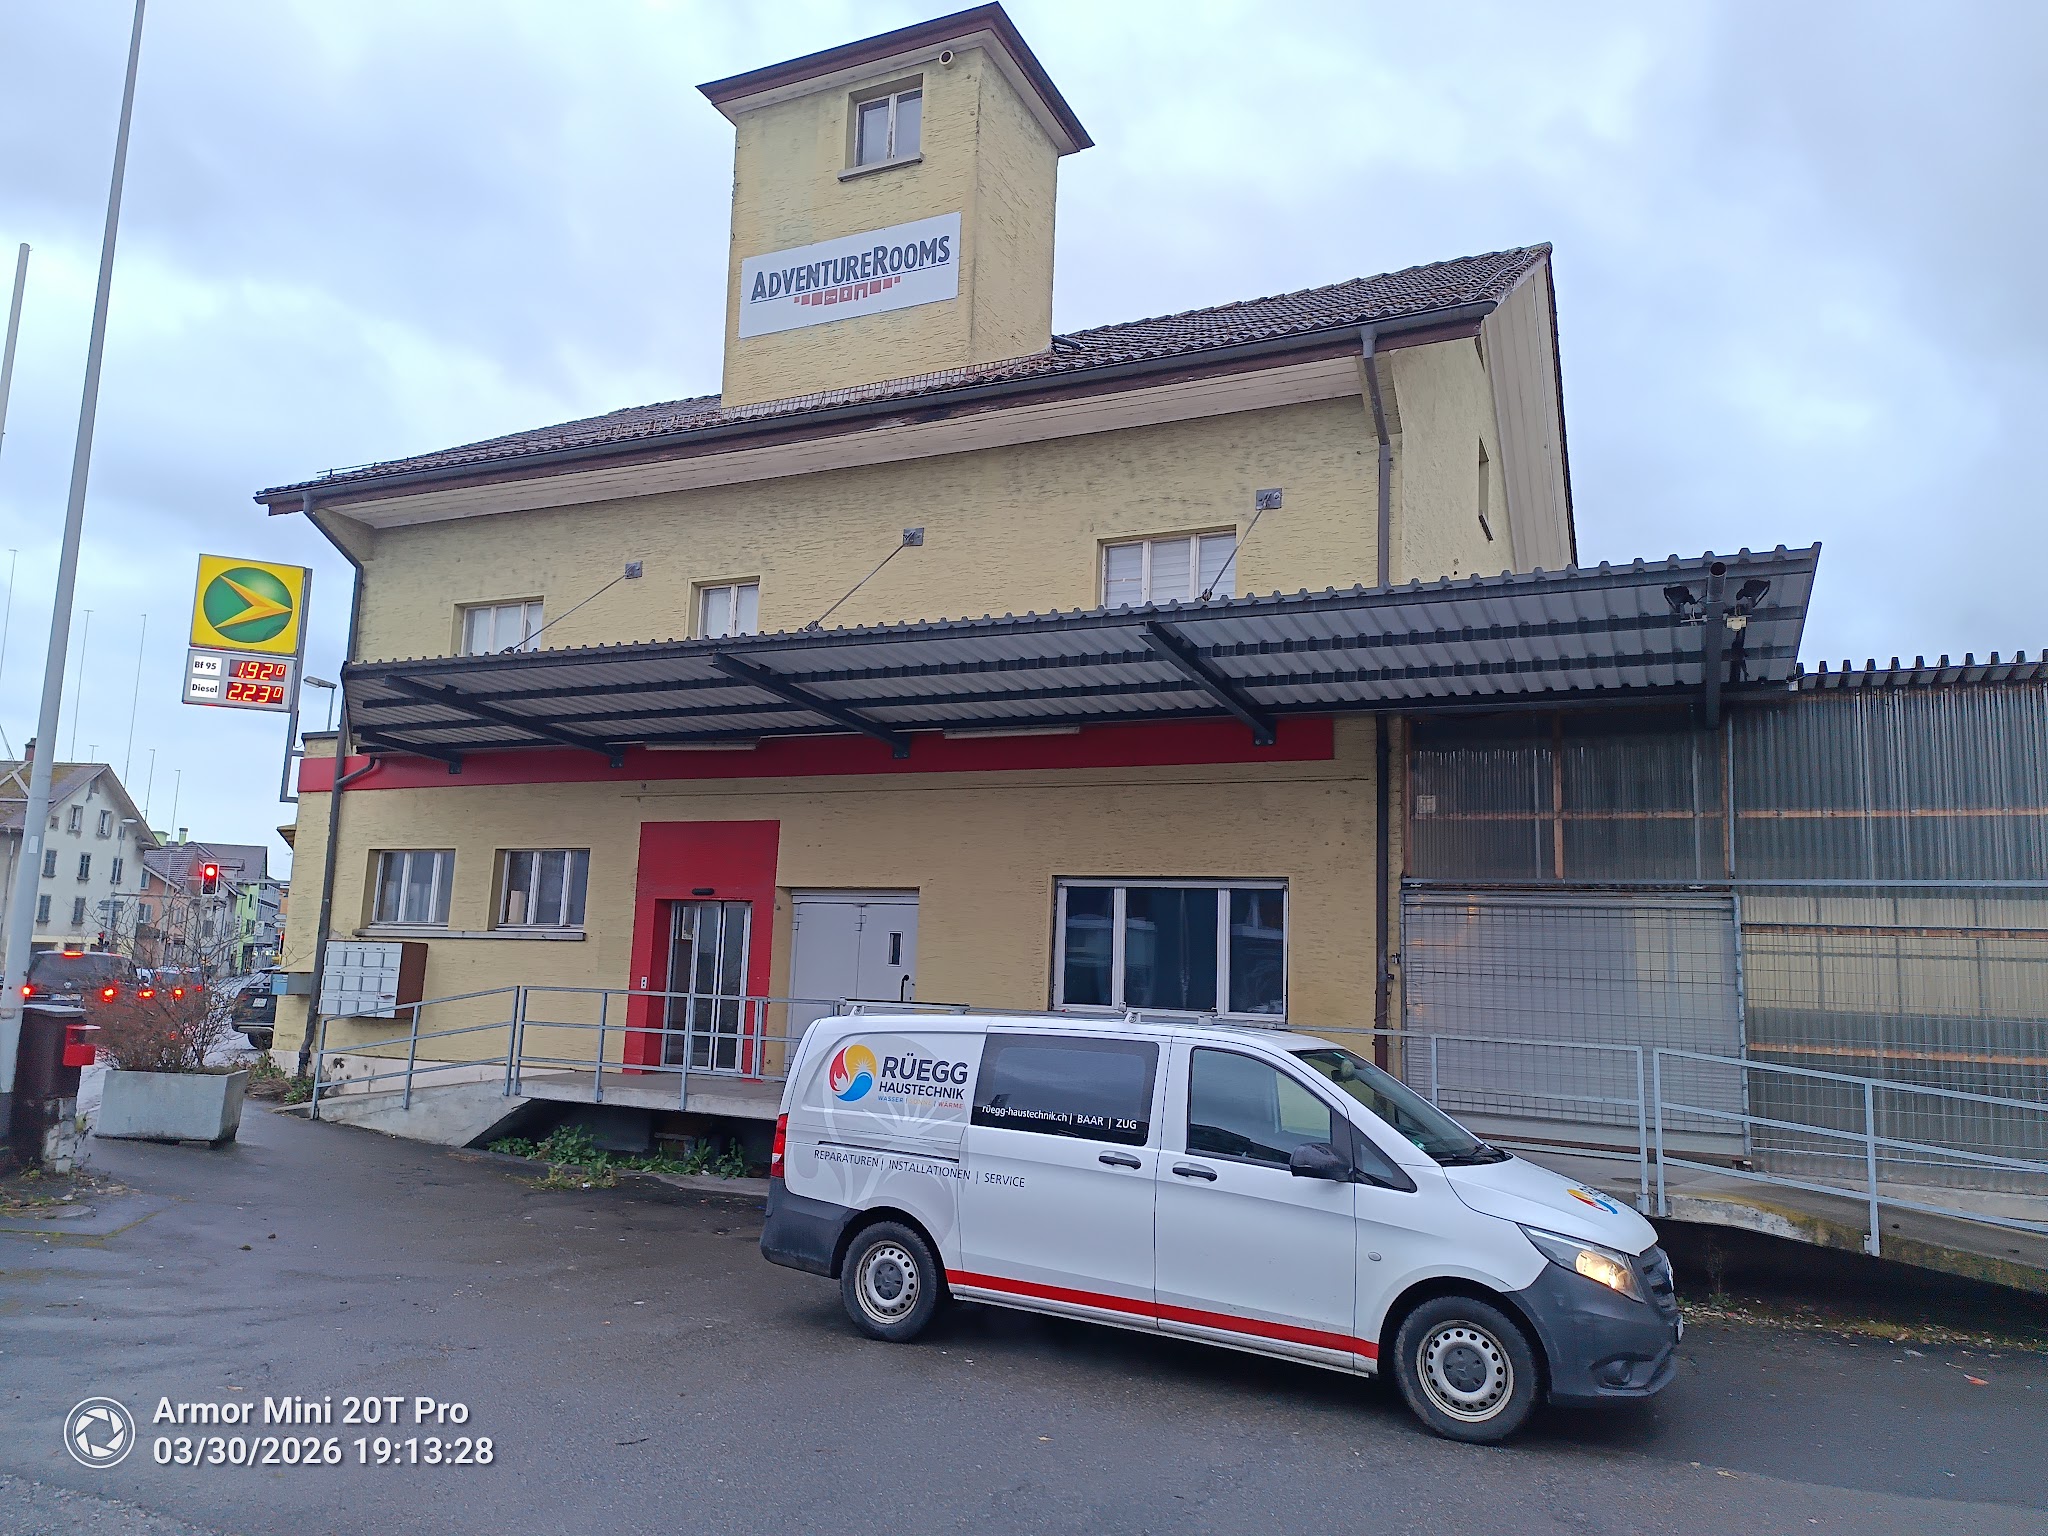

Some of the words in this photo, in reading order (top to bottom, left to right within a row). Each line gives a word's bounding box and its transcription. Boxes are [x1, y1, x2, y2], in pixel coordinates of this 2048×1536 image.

[205, 662, 217, 670] 95
[192, 683, 218, 693] Diesel
[881, 1052, 968, 1085] RÜEGG
[879, 1081, 965, 1100] HAUSTECHNIK
[877, 1095, 904, 1103] WASSER
[937, 1101, 964, 1110] WÄRME
[981, 1104, 1068, 1123] rüegg-haustechnik.ch
[1077, 1114, 1104, 1126] BAAR
[1116, 1118, 1138, 1130] ZUG
[814, 1149, 878, 1167] REPARATUREN
[889, 1159, 971, 1180] INSTALLATIONEN
[984, 1173, 1026, 1188] SERVICE
